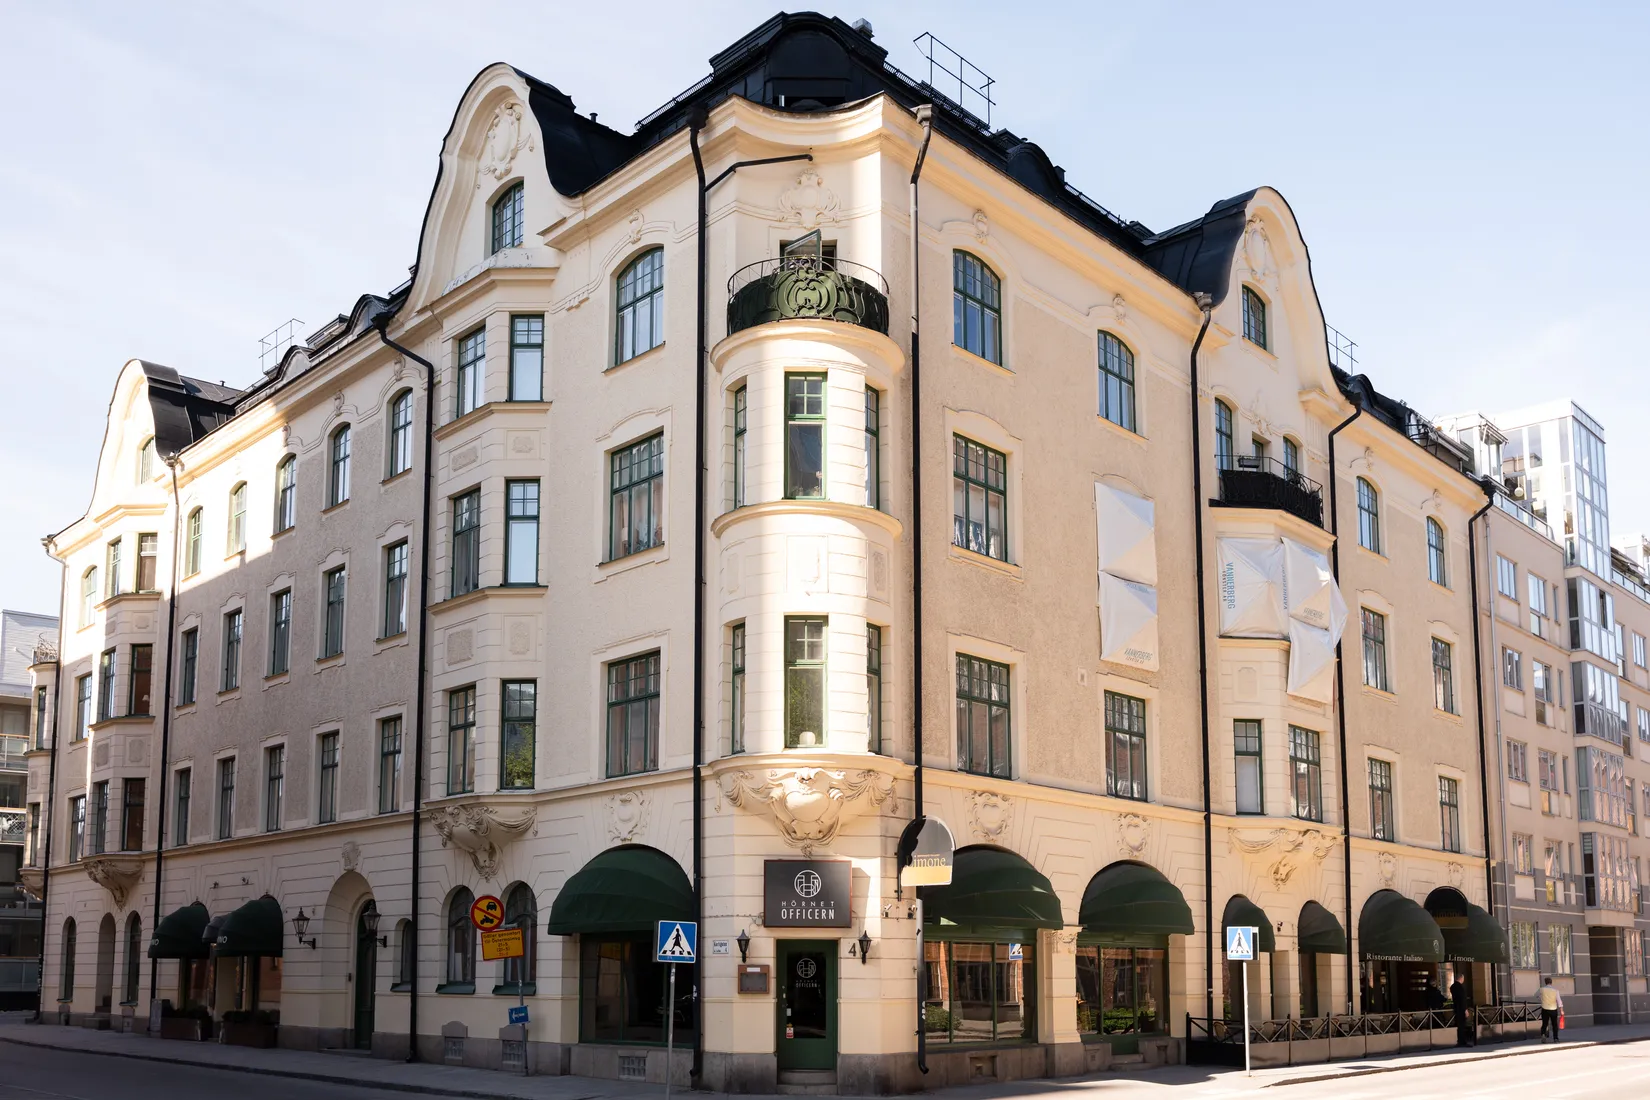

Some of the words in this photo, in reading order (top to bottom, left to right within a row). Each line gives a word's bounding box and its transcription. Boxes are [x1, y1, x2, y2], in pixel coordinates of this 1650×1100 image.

[1226, 562, 1235, 609] VANNERBERG
[781, 908, 835, 920] OFFICERN
[848, 942, 857, 957] 4
[1366, 952, 1402, 961] Ristorante
[1403, 954, 1424, 962] Italiano
[1448, 954, 1475, 962] Limone
